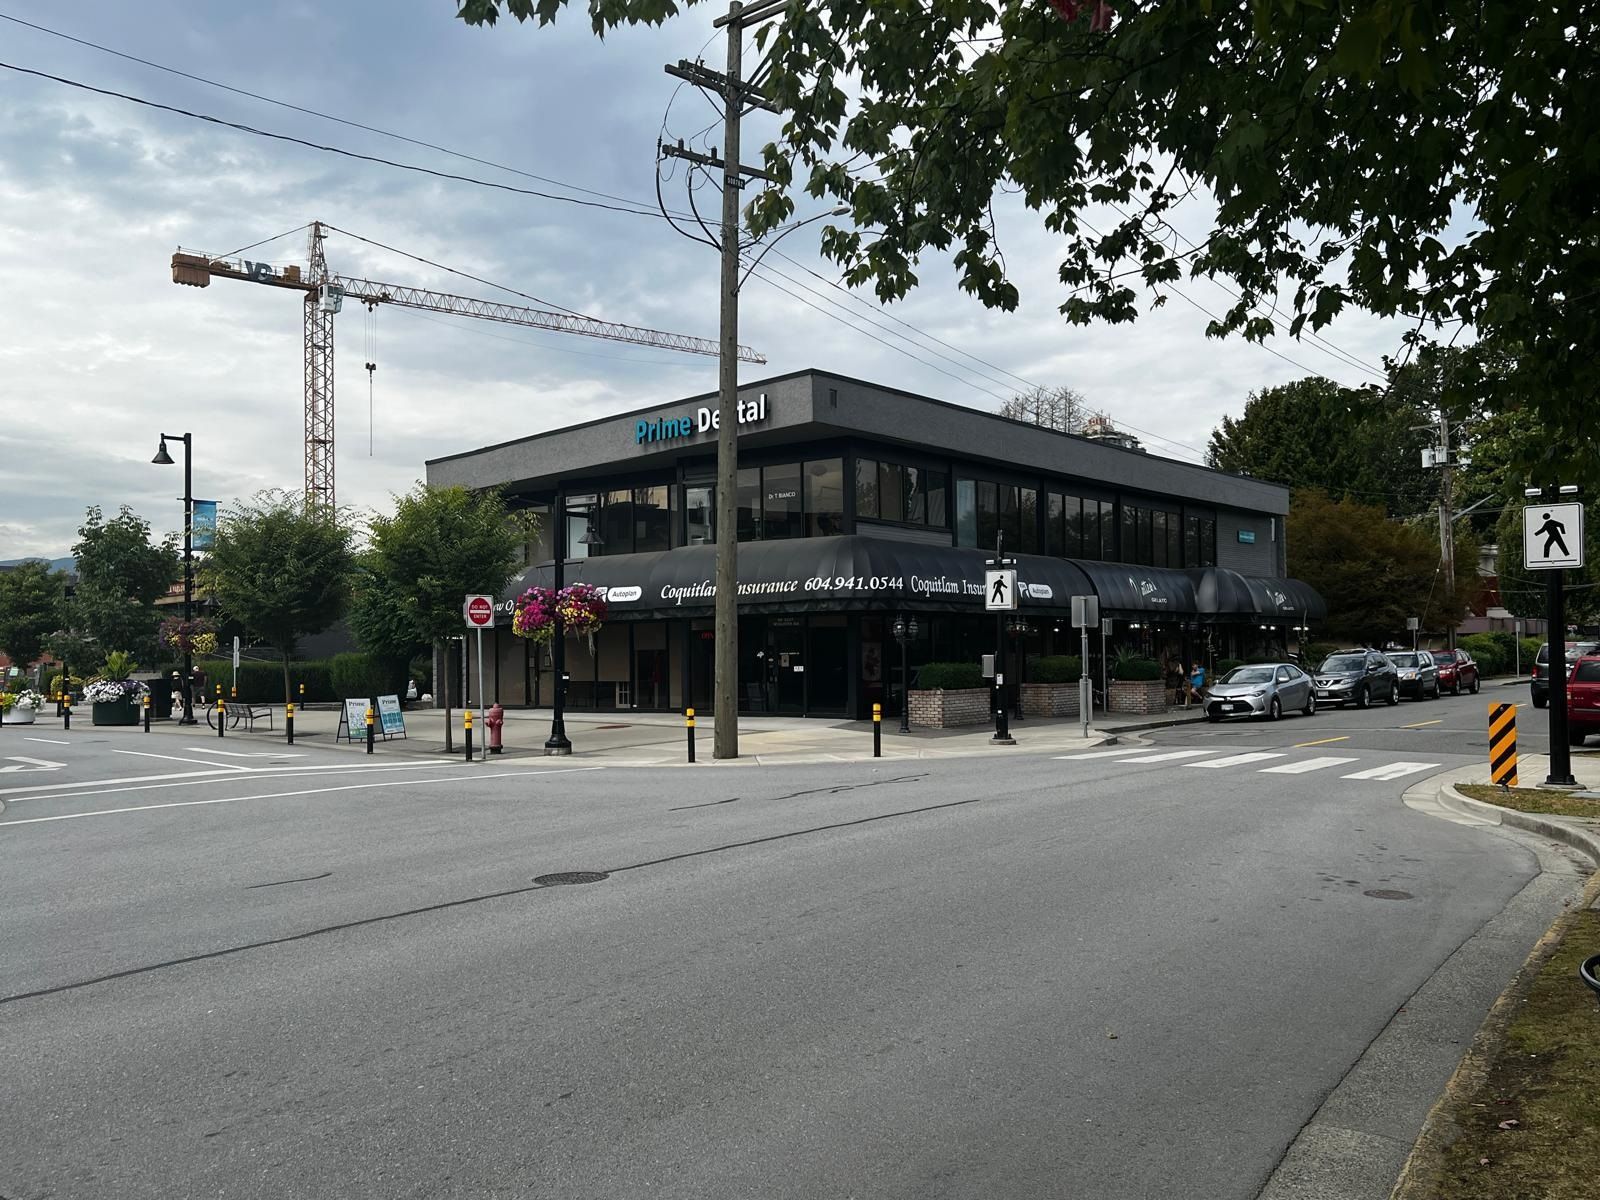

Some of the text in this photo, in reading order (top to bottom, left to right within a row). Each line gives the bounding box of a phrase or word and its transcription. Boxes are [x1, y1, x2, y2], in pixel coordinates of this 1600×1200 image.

[635, 393, 767, 444] Prime Detal
[612, 590, 637, 598] Autoplan
[736, 580, 798, 595] nsurance
[804, 576, 903, 591] 604.941.0544
[911, 575, 959, 597] Coquitlam
